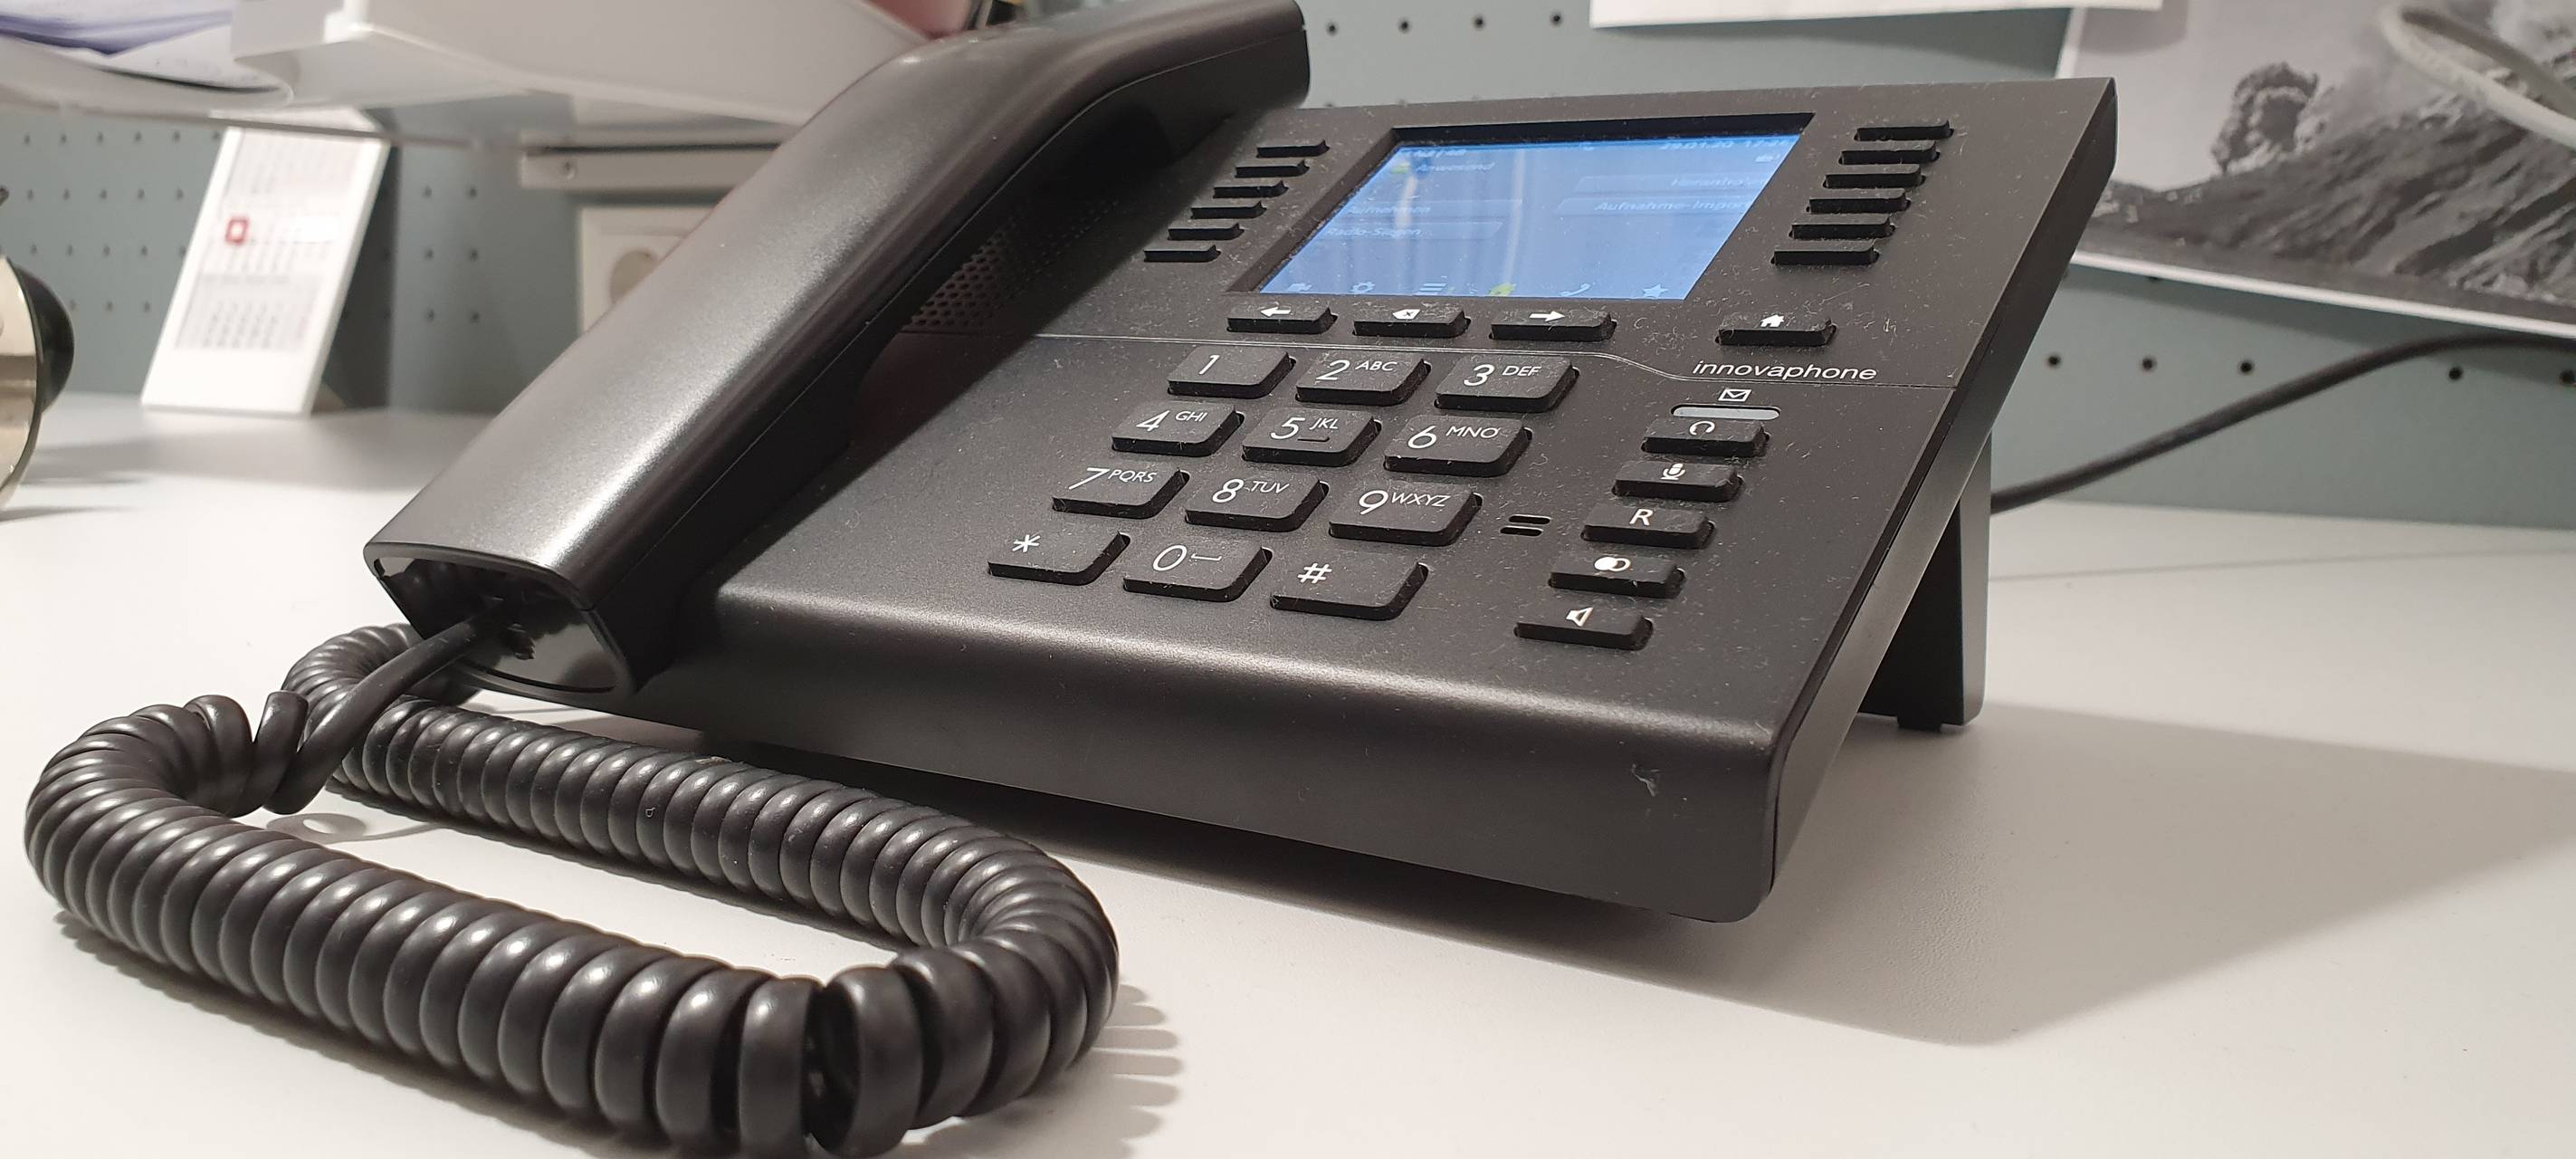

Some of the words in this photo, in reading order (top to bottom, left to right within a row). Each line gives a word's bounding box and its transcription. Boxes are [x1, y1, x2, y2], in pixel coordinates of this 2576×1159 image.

[1199, 355, 1219, 374] 1
[1316, 360, 1350, 380] 2
[1355, 360, 1397, 370] ABC
[1693, 360, 1877, 381] innovaphone
[1465, 365, 1494, 386] 3
[1503, 366, 1541, 376] DEF
[1136, 410, 1169, 431] 4
[1176, 411, 1207, 421] GHI
[1271, 417, 1305, 438] 5
[1310, 418, 1338, 429] JKL
[1408, 426, 1436, 448] 6
[1446, 426, 1501, 437] MNO
[1069, 468, 1105, 489] 7
[1107, 469, 1157, 482] PQRS
[1213, 479, 1244, 503] 8
[1251, 481, 1289, 493] TUV
[1360, 491, 1388, 514] 9
[1392, 493, 1451, 506] WXYZ
[1630, 509, 1653, 525] R
[1153, 545, 1187, 570] 0
[1298, 563, 1331, 583] #
